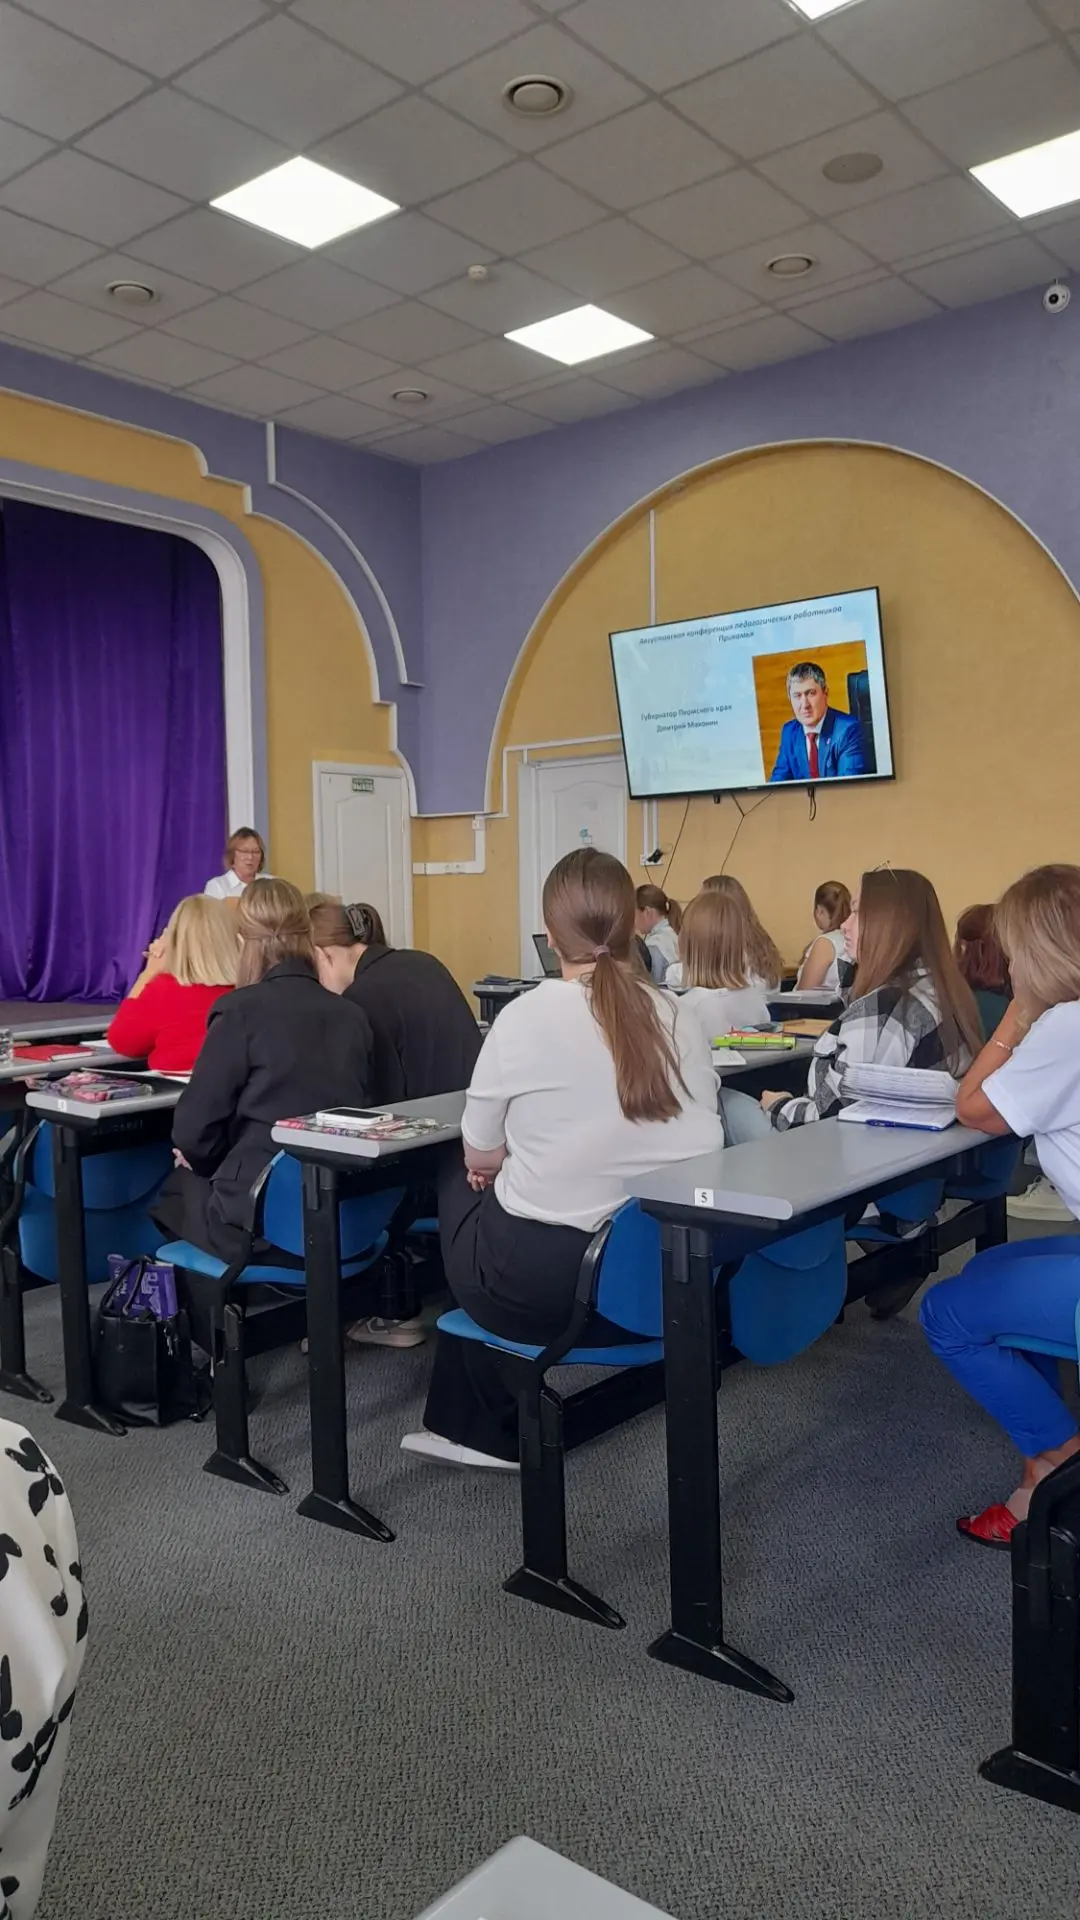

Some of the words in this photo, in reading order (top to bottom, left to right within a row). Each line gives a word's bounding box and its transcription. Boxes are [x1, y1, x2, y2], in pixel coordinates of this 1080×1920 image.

[686, 624, 733, 638] конференция
[734, 615, 792, 629] педагогических
[793, 606, 843, 621] работников
[641, 711, 678, 721] Губернатор
[678, 706, 714, 717] Пермского
[656, 723, 686, 733] Дмитрий
[701, 1191, 708, 1203] 5
